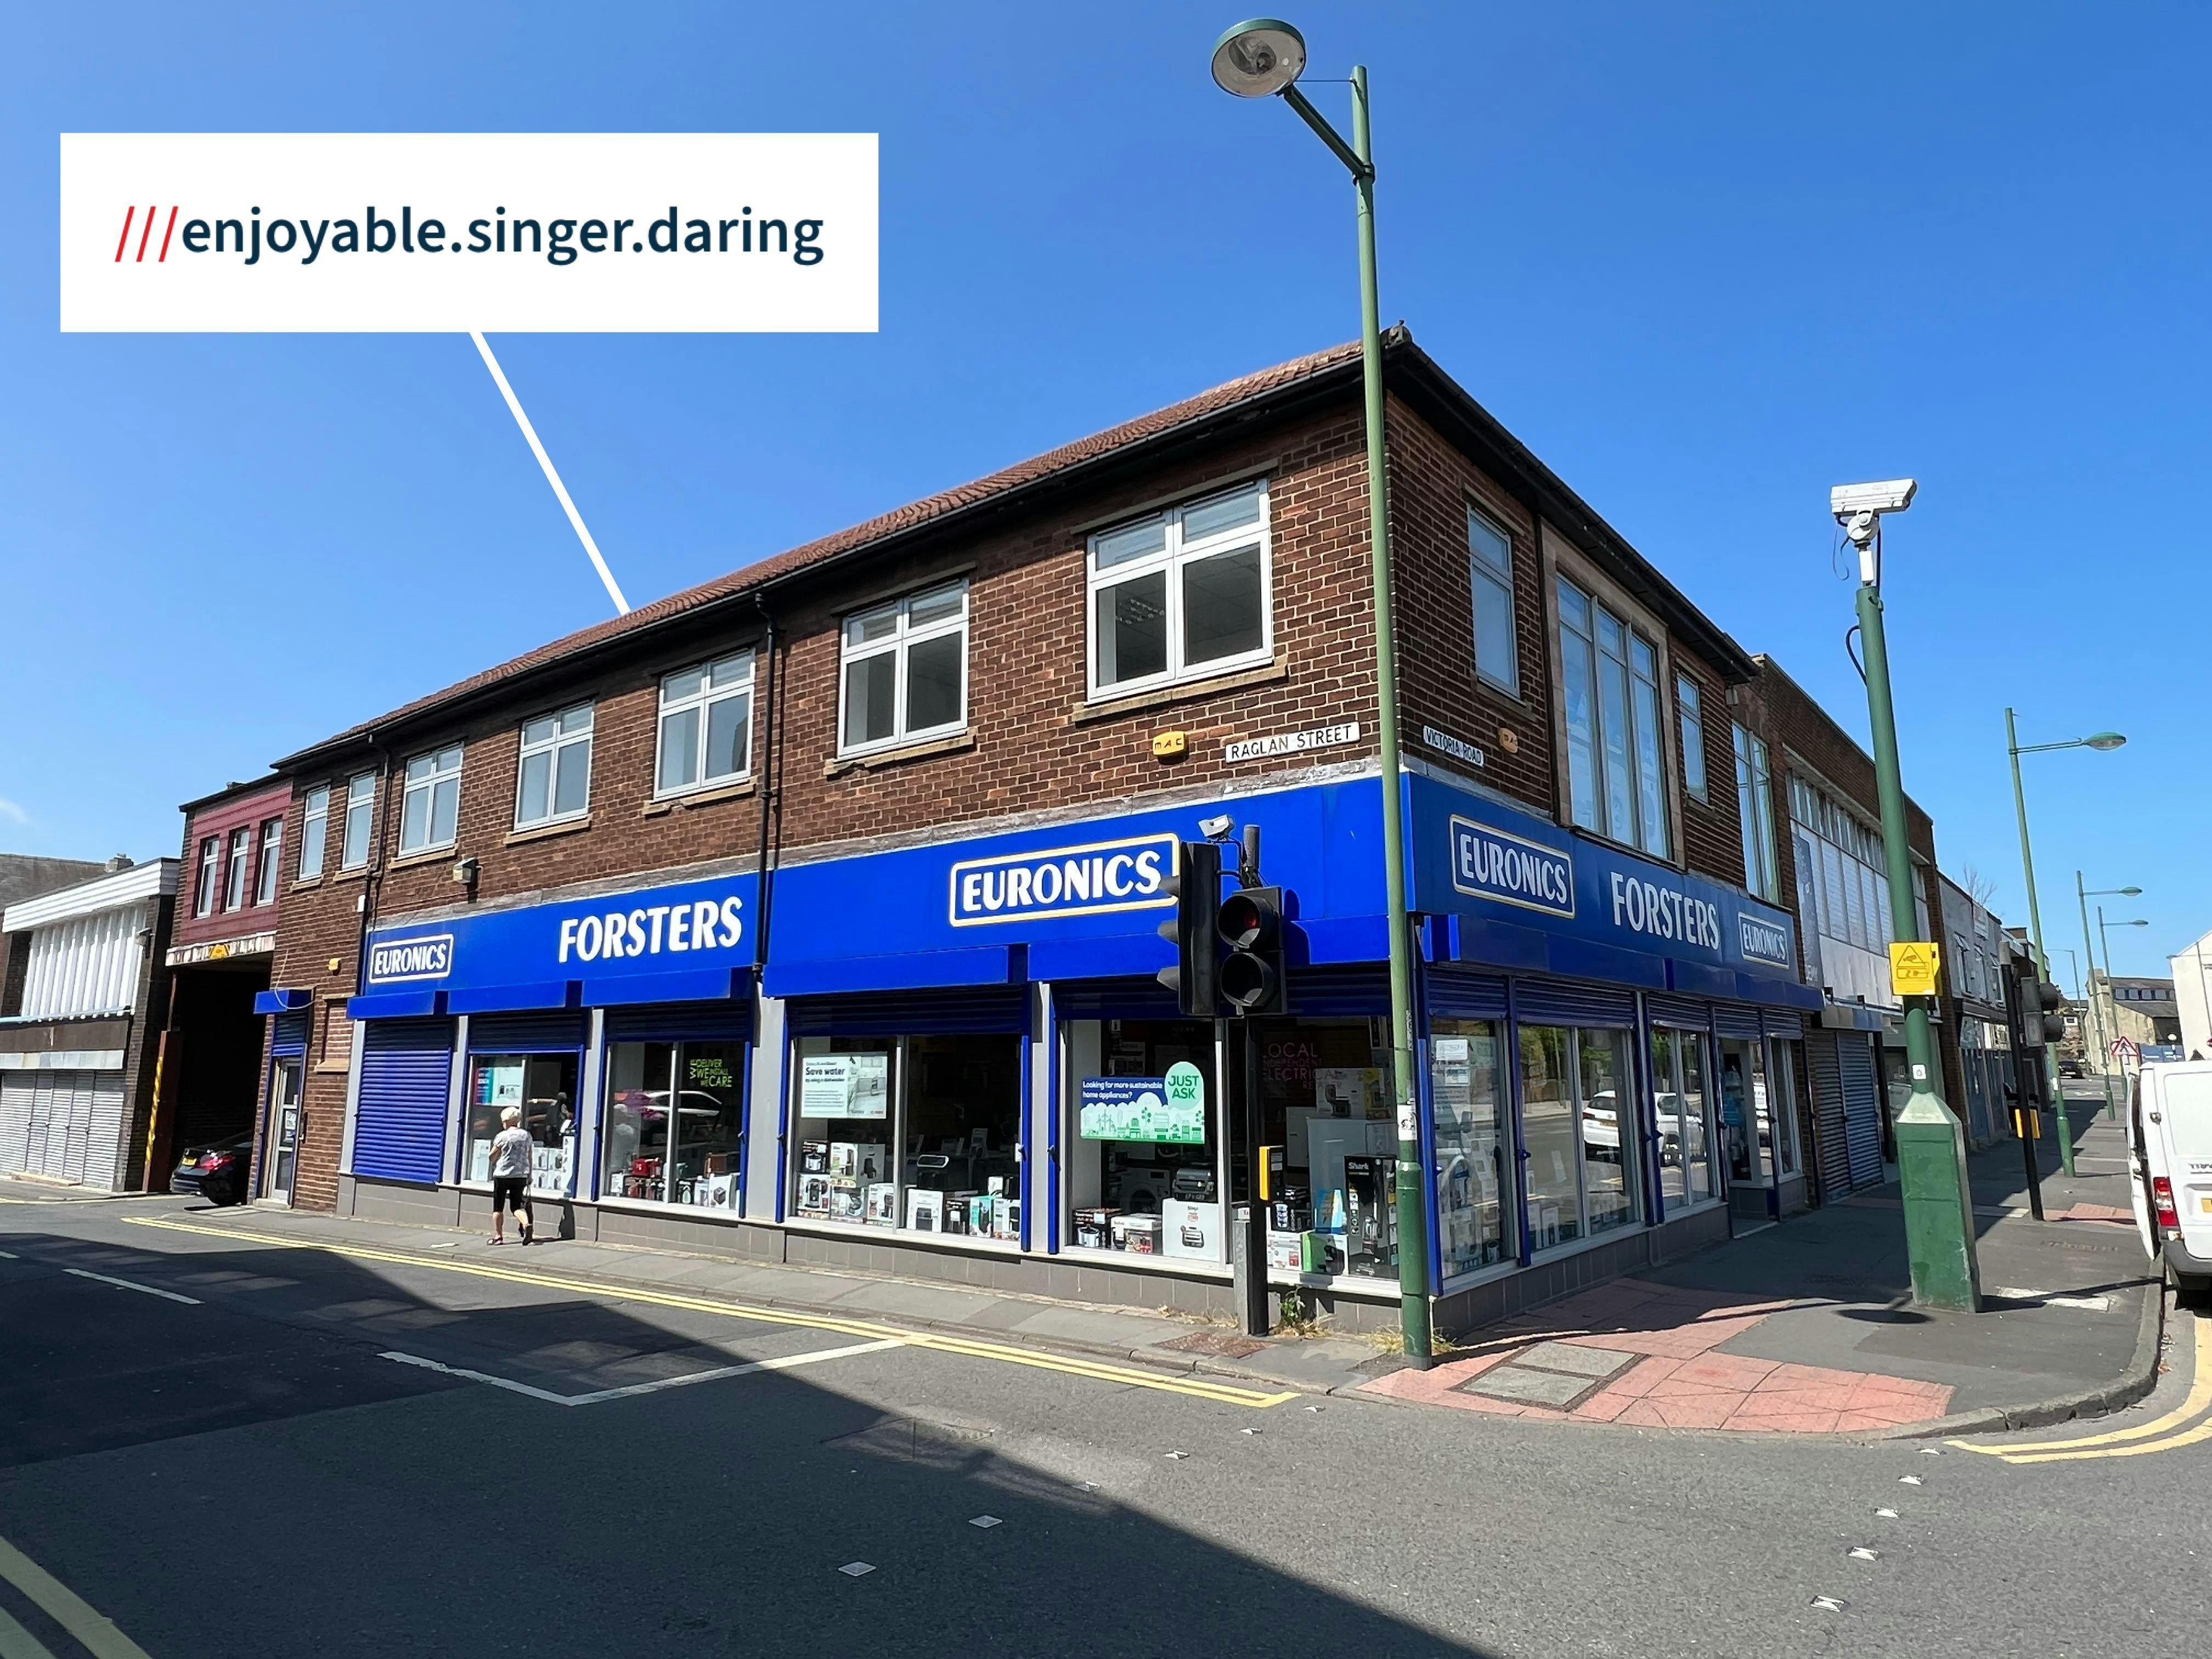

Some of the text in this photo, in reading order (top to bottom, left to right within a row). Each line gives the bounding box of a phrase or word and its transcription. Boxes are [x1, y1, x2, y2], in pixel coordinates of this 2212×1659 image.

[1231, 725, 1352, 759] RAGLAN STREET
[1426, 727, 1482, 764] VICTORIA ROAD
[1459, 833, 1567, 905] EURONICS
[962, 849, 1161, 912] EURONICS
[1610, 871, 1719, 951] FORSTERS
[558, 895, 743, 964] FORSTERS
[1742, 922, 1787, 961] EURONICS
[374, 943, 447, 975] EURONICS
[1262, 1042, 1318, 1058] OCAL
[697, 1068, 709, 1079] WE
[805, 1066, 823, 1075] Save
[709, 1075, 733, 1087] CARE
[1082, 1081, 1105, 1090] Looking
[1167, 1075, 1199, 1086] JUST
[1098, 1091, 1133, 1099] appliances?
[1172, 1087, 1196, 1099] ASK
[1348, 1161, 1369, 1170] Shark
